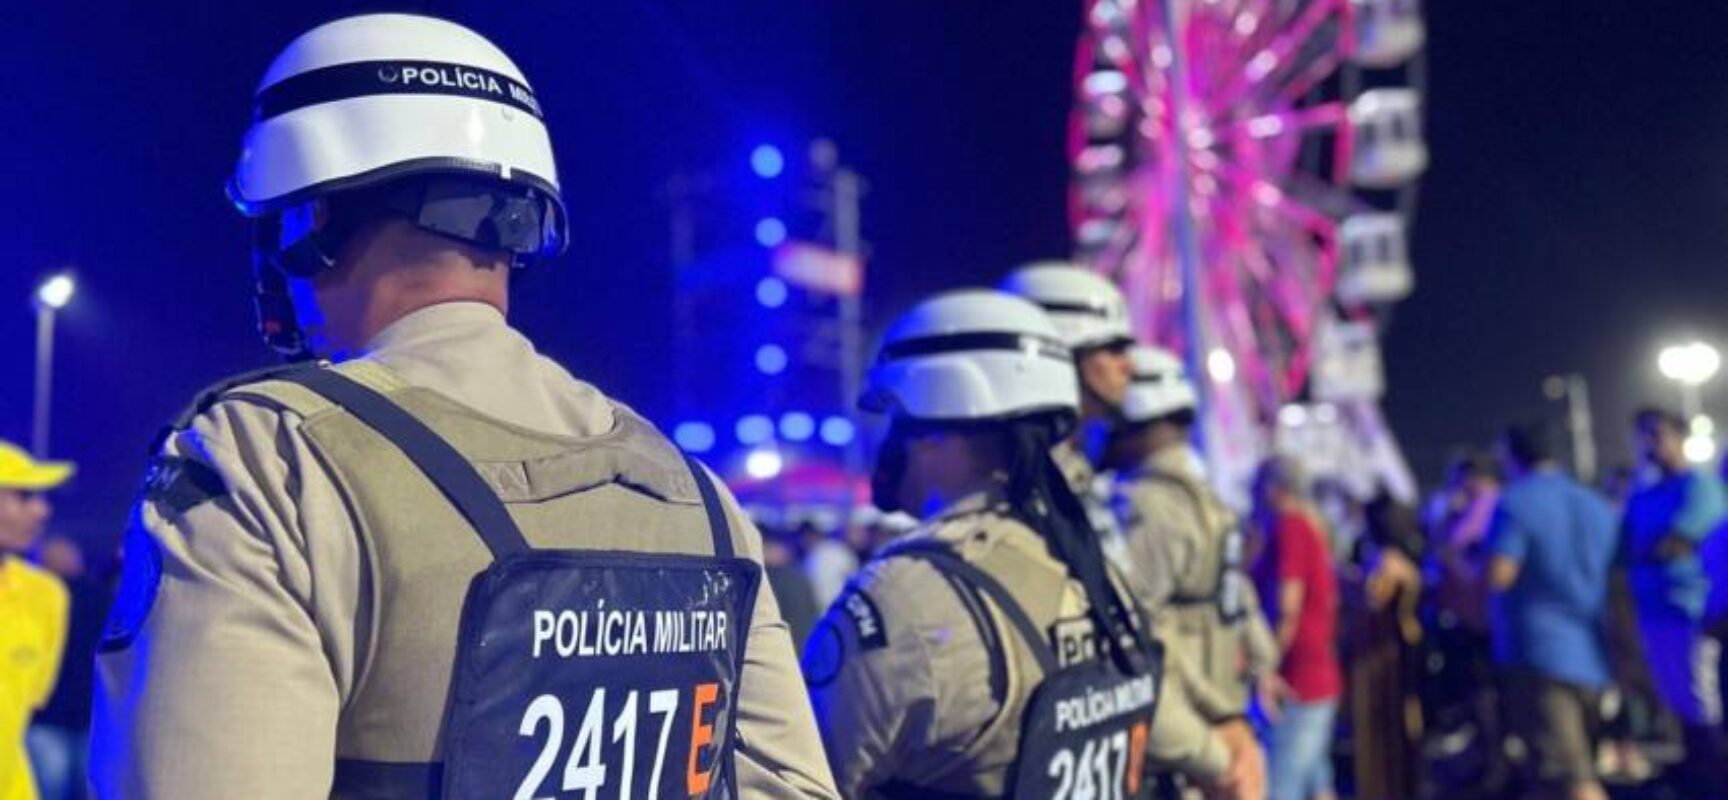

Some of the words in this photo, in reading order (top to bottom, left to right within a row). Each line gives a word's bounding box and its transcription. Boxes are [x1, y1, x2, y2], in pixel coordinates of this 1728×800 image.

[401, 67, 503, 95] POLÍCIA
[532, 599, 648, 657] POLÍCIA
[653, 611, 727, 653] MILITAR
